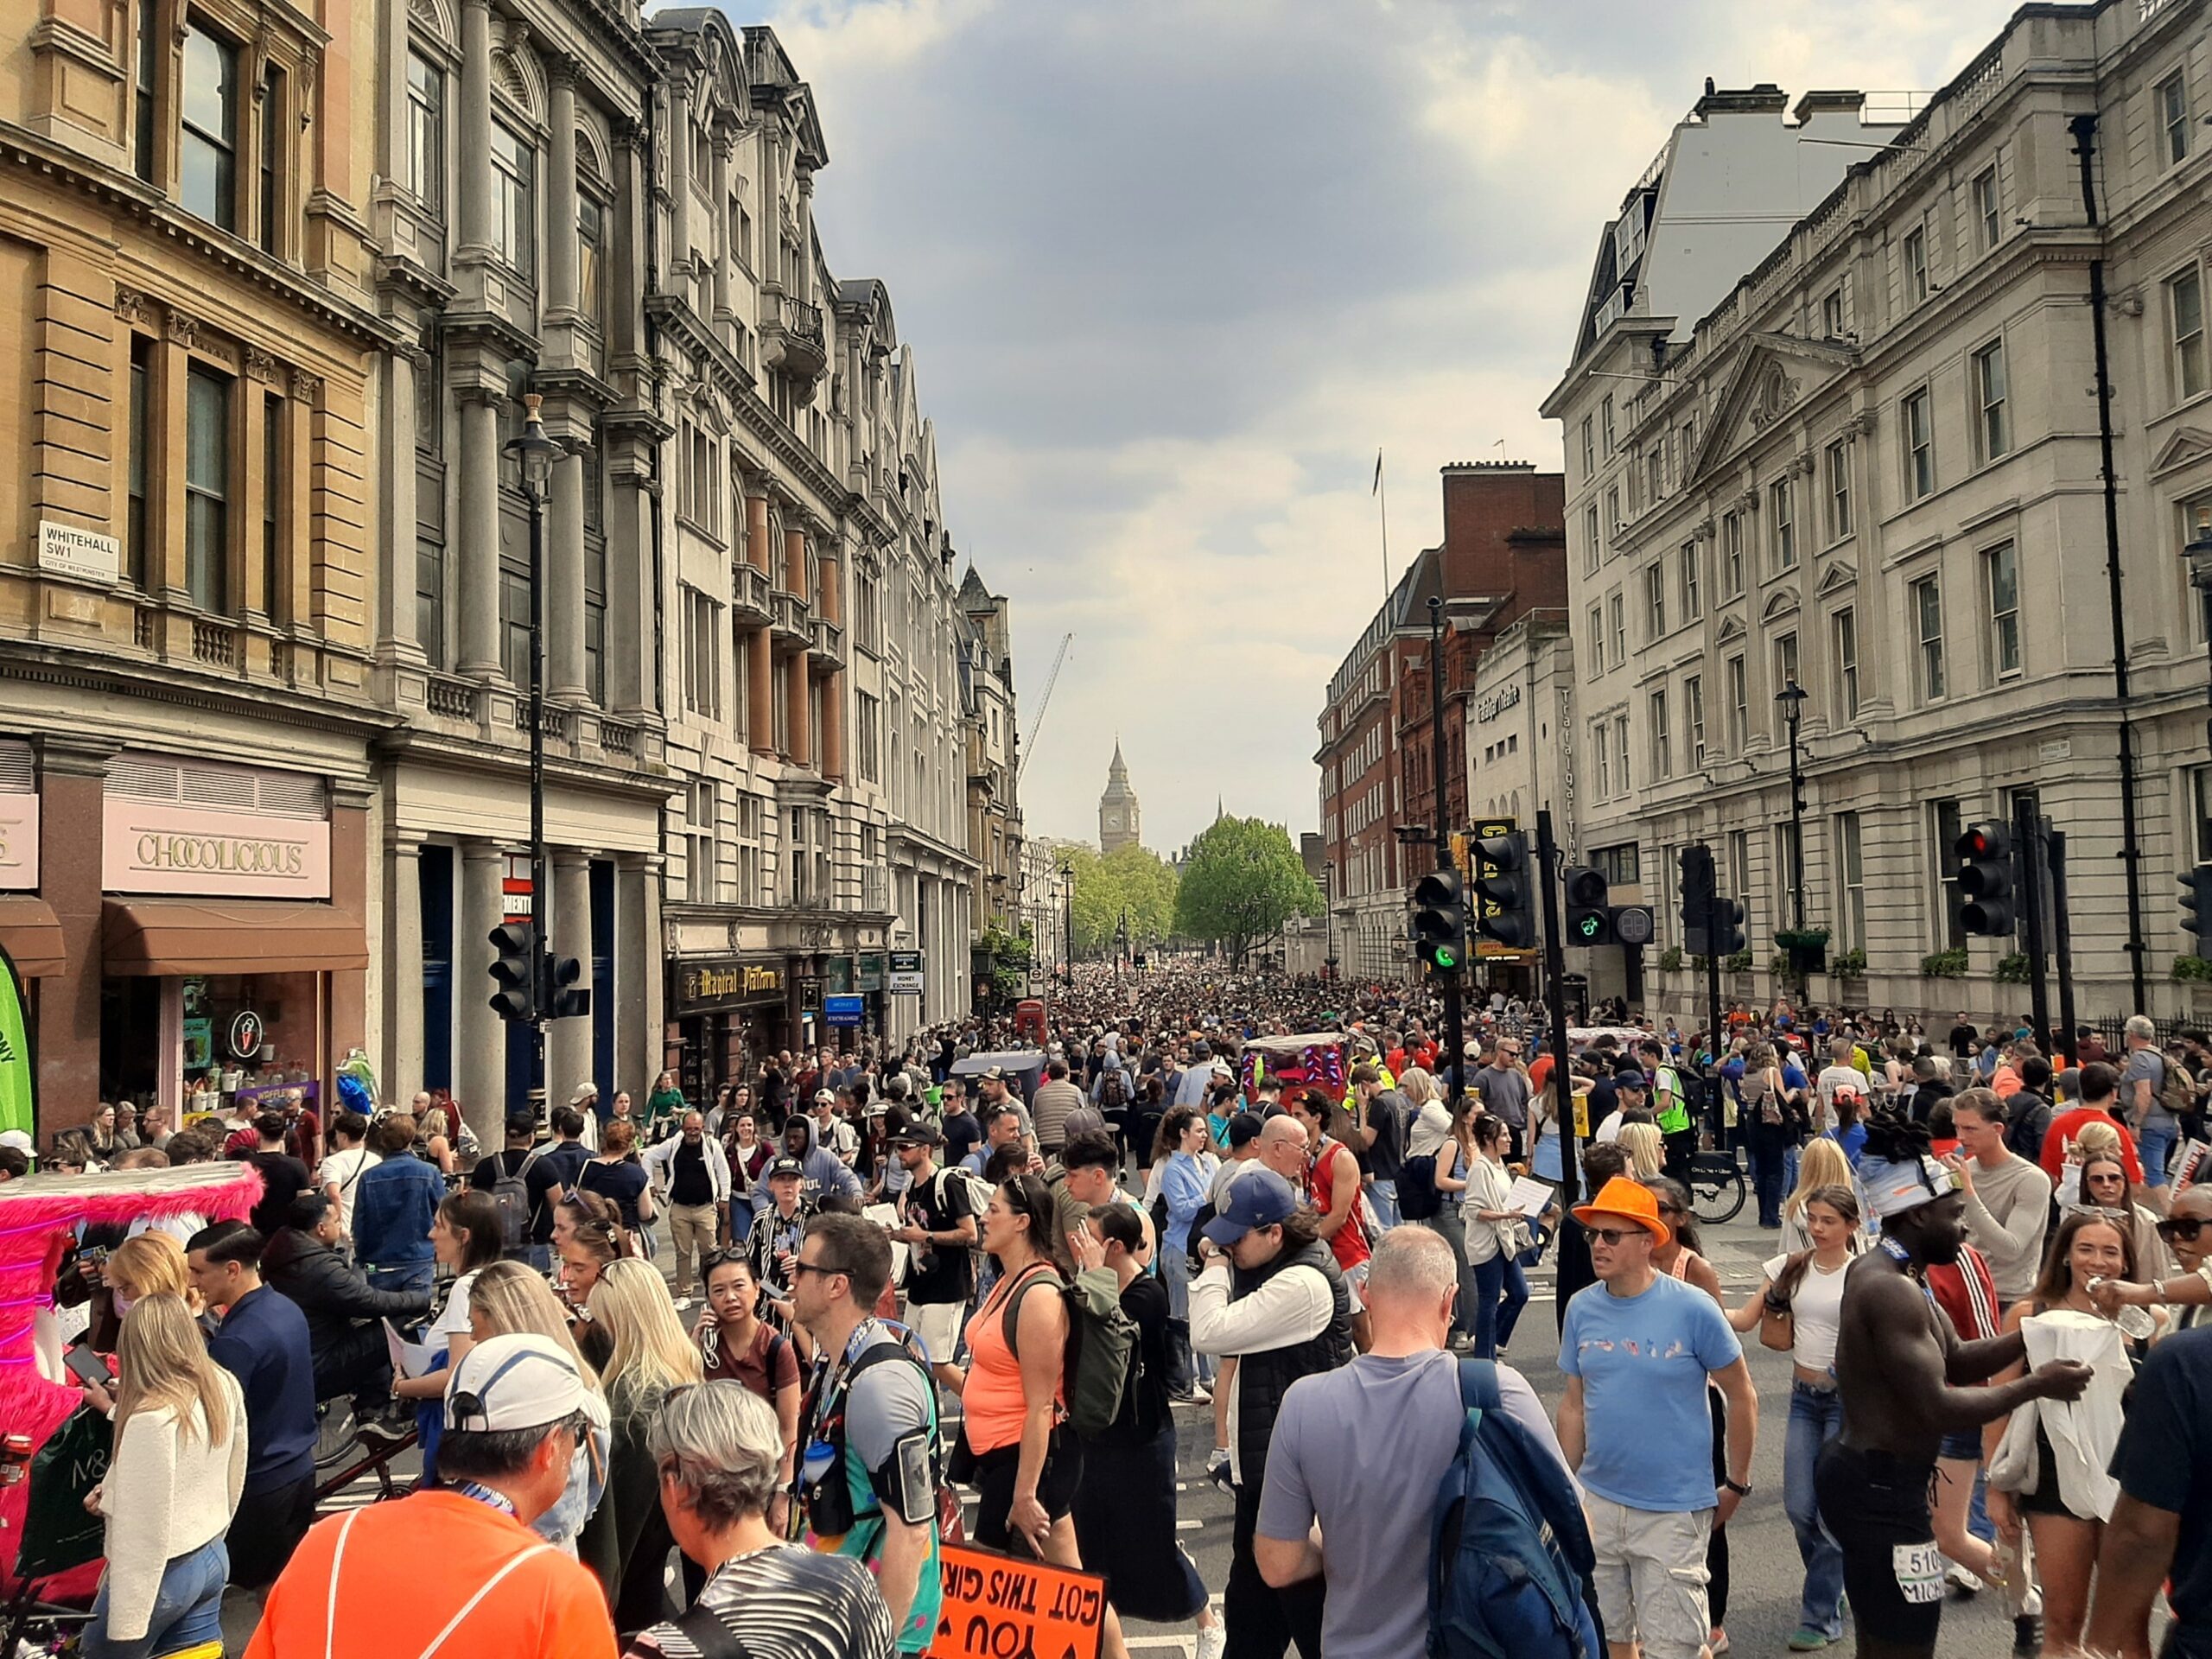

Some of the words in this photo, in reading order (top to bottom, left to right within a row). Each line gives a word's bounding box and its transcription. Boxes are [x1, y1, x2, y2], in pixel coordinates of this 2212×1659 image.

[46, 542, 71, 558] SW1
[47, 527, 113, 554] WHITEHALL
[45, 559, 57, 568] CITY
[67, 564, 105, 578] WESTMINSTER
[1478, 696, 1499, 723] Trafalgar
[1497, 683, 1521, 711] Theatre
[1561, 690, 1574, 811] Trafalgar
[137, 834, 302, 874] CHOCOLICIOUS
[1567, 820, 1577, 862] The
[700, 969, 737, 1001] Magical
[742, 965, 776, 997] Platform
[0, 1031, 16, 1062] NY
[1910, 1548, 1942, 1573] 510
[986, 1569, 1038, 1616] THIS
[1047, 1581, 1100, 1626] GOT
[963, 1614, 1038, 1659] YOU
